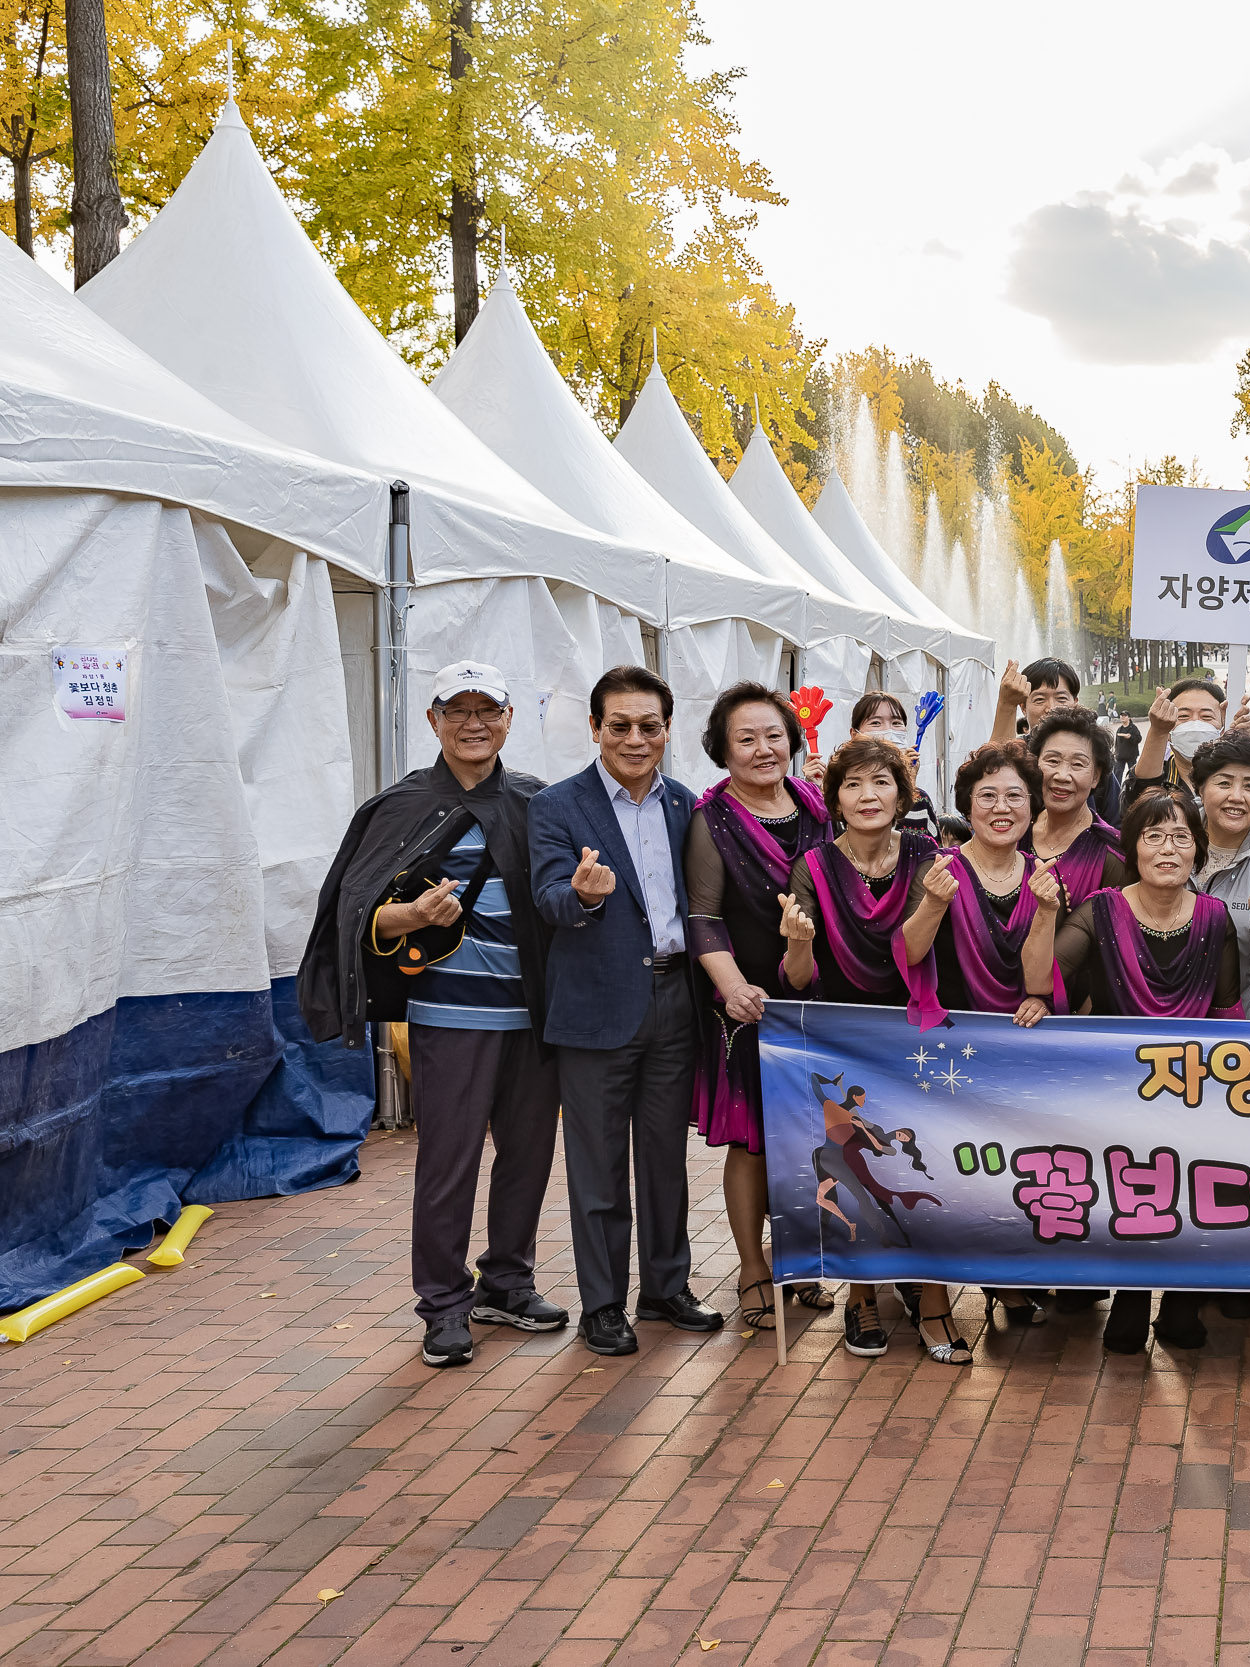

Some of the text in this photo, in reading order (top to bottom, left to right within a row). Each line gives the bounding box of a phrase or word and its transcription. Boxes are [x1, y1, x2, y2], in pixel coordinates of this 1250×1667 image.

[69, 682, 118, 693] 꽃보다 청춘
[82, 695, 113, 706] 김정민
[1231, 902, 1249, 910] SEOU
